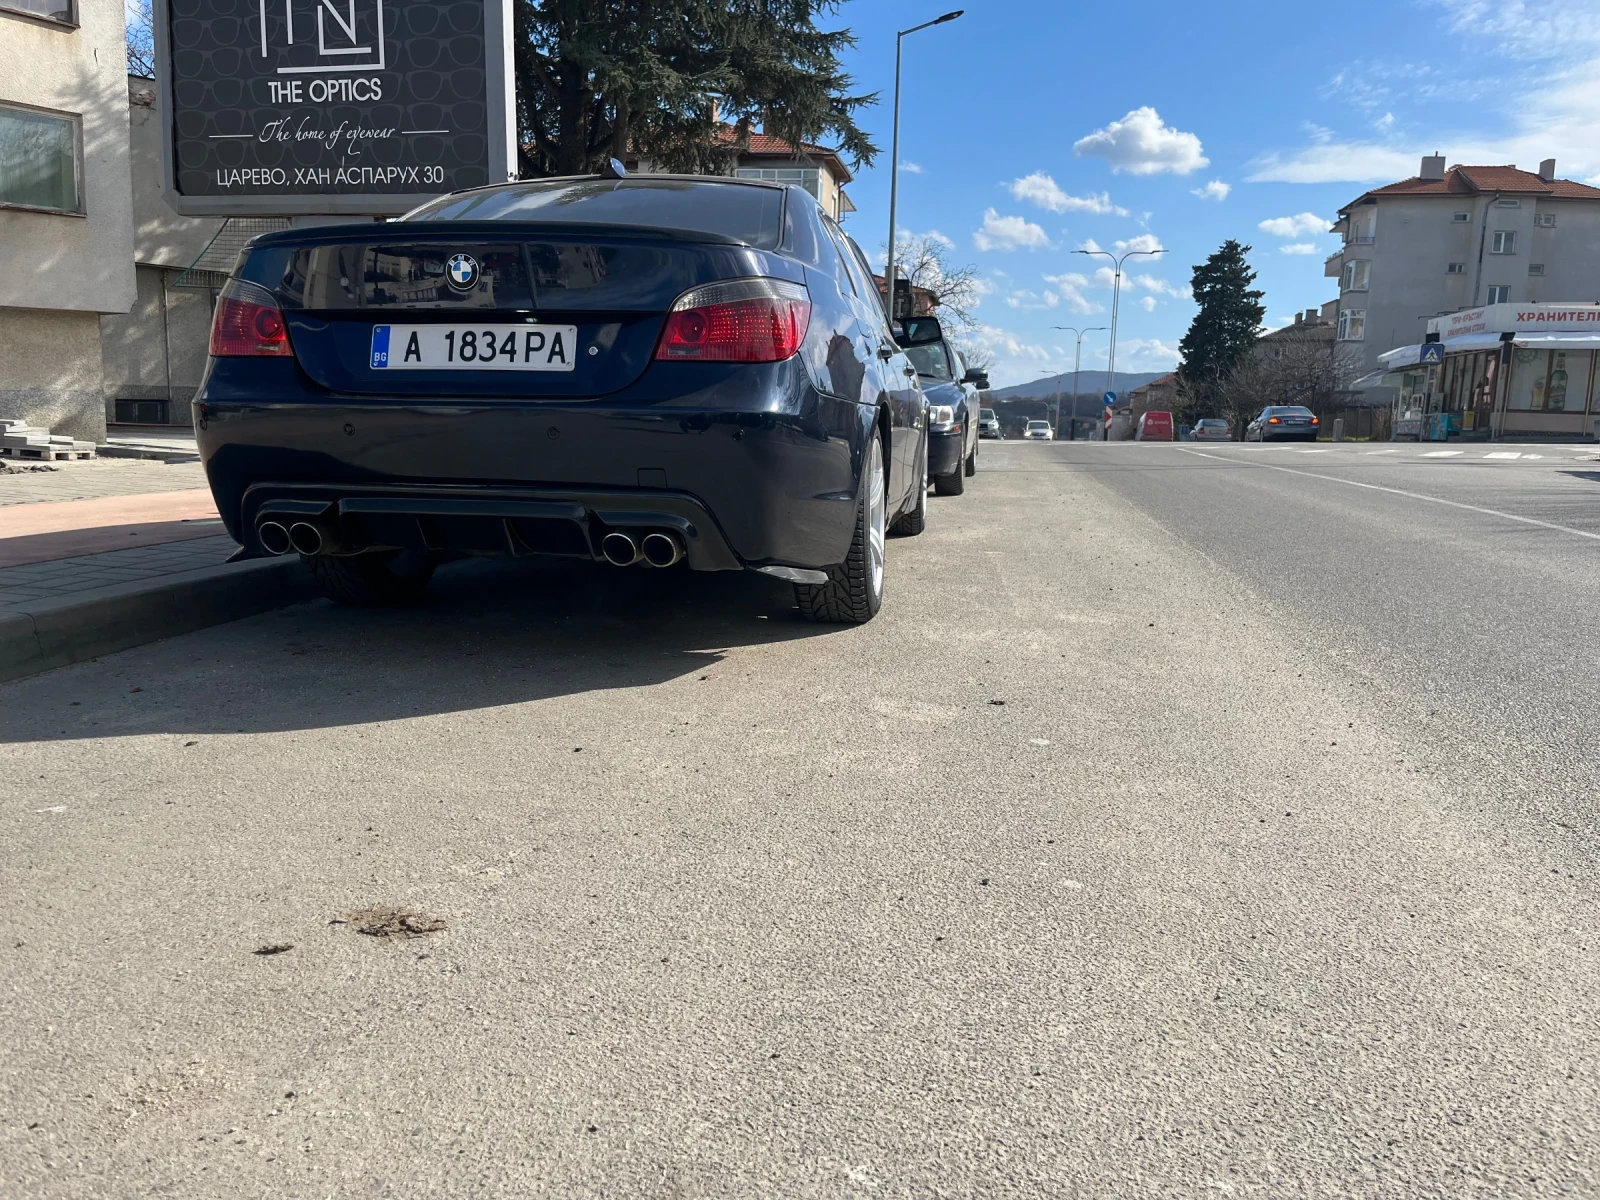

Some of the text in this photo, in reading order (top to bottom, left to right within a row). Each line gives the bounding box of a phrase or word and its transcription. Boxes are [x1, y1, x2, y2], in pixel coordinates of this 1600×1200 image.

[267, 77, 382, 103] THE OPTICS
[258, 115, 396, 156] The home of eyewear
[217, 165, 444, 187] ЦАРЕВО, ХАН АСПАРУХ 30
[1516, 312, 1600, 322] ХРАНИТЕЛ
[374, 352, 387, 362] BG
[404, 331, 422, 363] A
